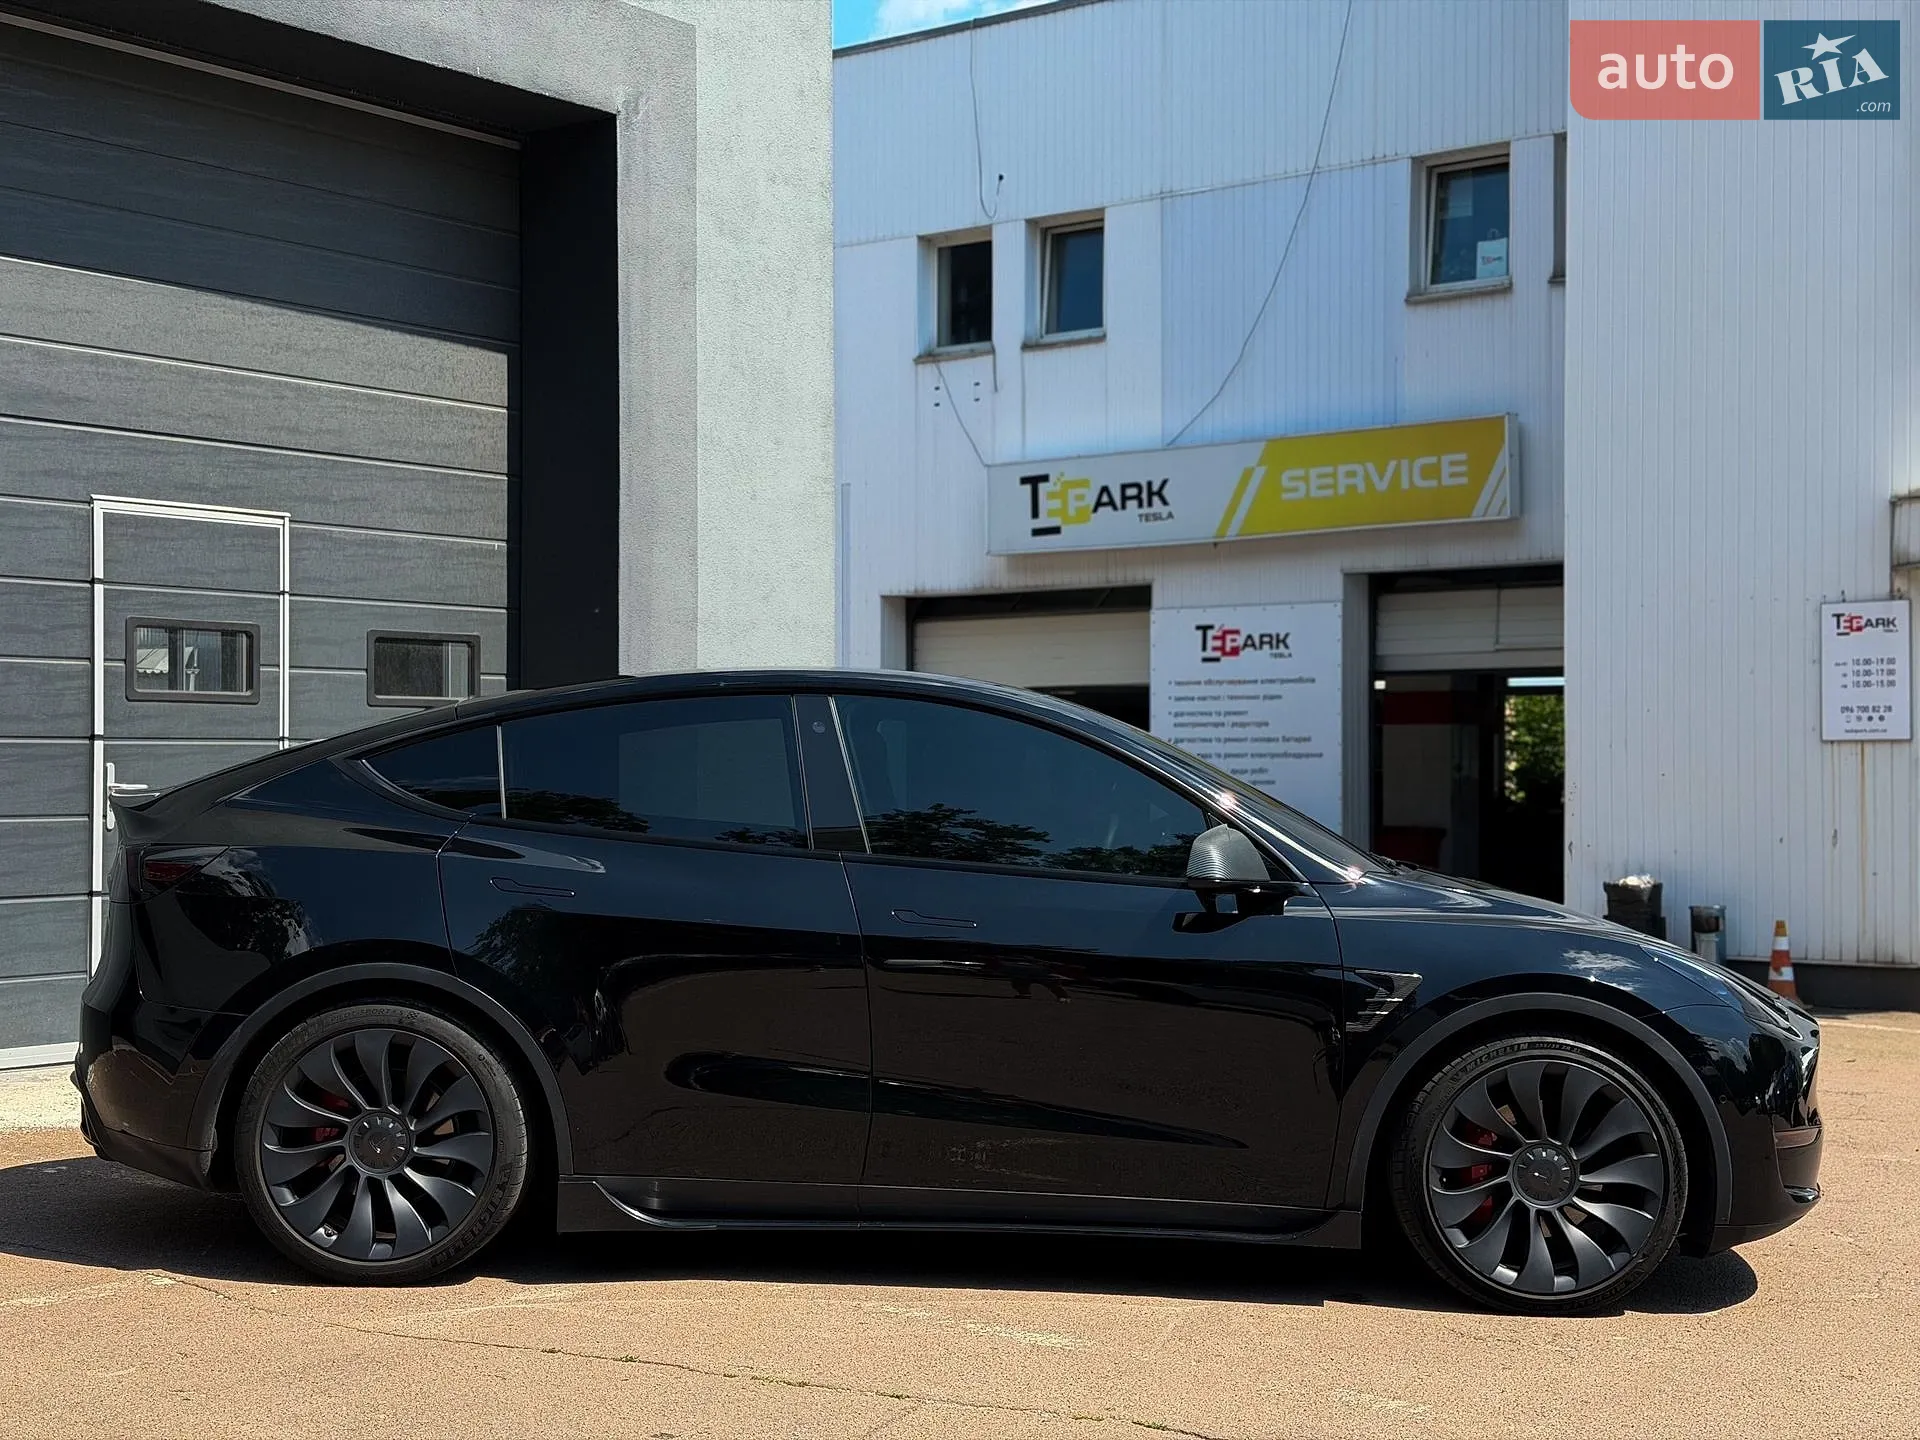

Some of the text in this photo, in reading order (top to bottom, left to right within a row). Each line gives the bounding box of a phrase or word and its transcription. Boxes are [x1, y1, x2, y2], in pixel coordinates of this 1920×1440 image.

[1280, 453, 1469, 501] SERVICE
[1137, 511, 1175, 524] TESLA
[1466, 1042, 1529, 1072] MICHELIN
